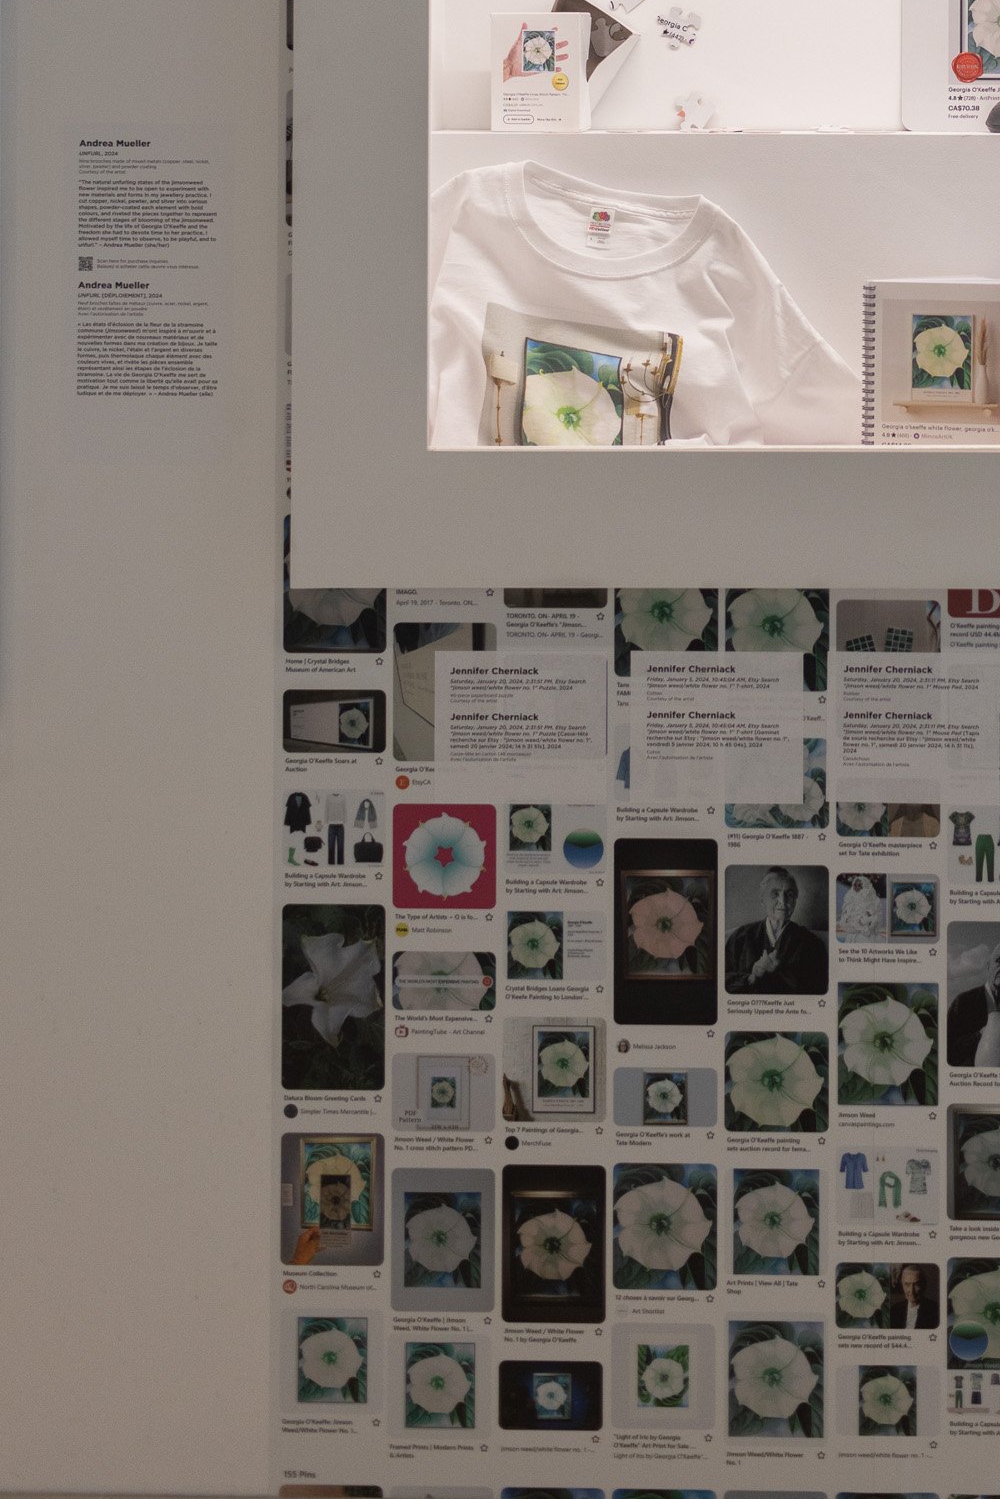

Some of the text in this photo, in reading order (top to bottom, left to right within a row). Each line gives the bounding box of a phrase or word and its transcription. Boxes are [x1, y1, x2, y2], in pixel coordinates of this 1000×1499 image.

[450, 667, 538, 675] Jennifer Cherniack
[688, 665, 735, 673] Cherniack
[844, 665, 882, 673] Jennifer
[491, 713, 538, 721] Cherniack
[647, 711, 735, 719] Jennifer Cherniack
[324, 1095, 349, 1103] Greeting
[283, 1470, 316, 1478] 155 Pins
